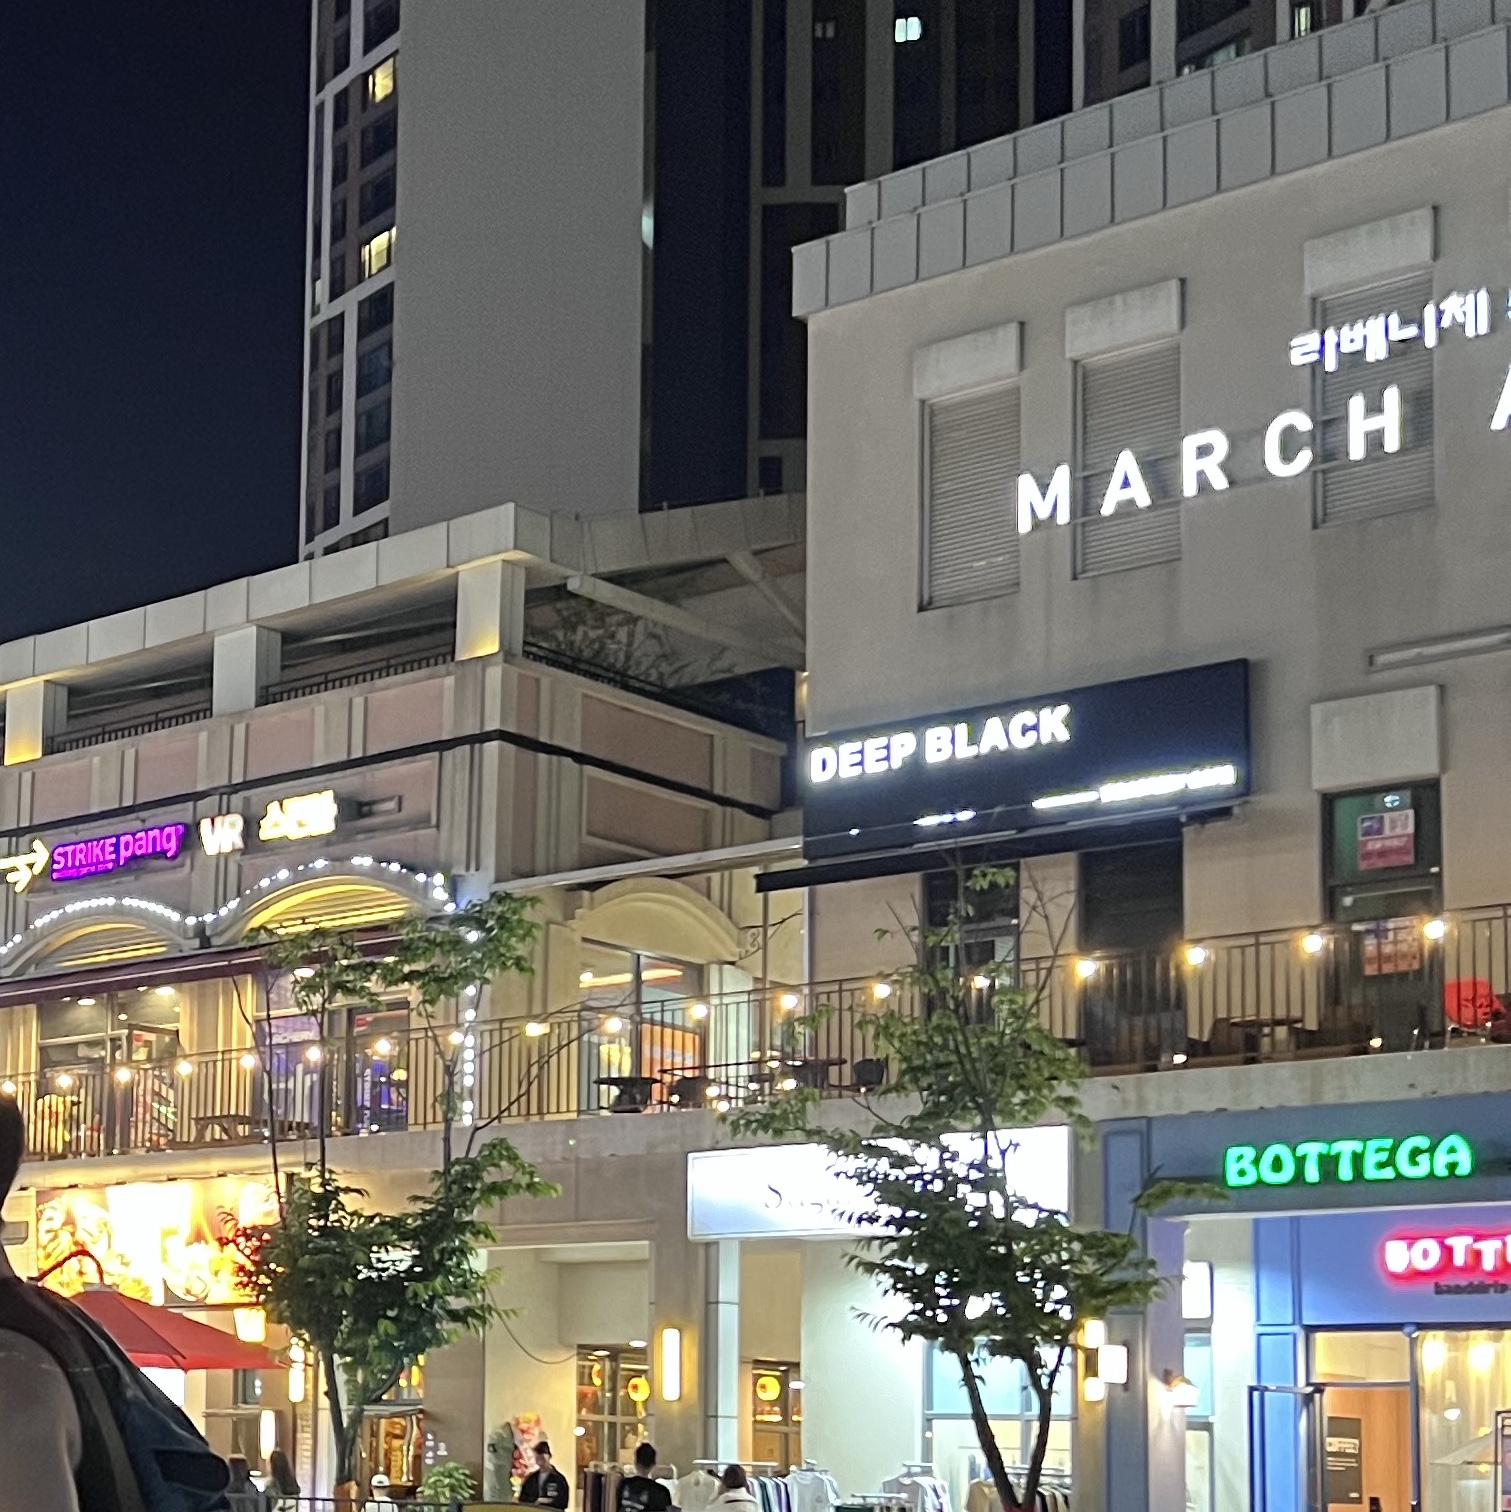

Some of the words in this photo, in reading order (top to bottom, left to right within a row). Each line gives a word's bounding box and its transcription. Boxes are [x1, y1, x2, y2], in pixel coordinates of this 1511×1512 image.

[1290, 287, 1491, 373] 라베니체
[1016, 384, 1402, 535] MARCH
[810, 731, 917, 783] DEEP
[924, 704, 1071, 764] BLACK
[52, 837, 116, 870] STRIKE
[119, 825, 176, 865] pang
[199, 813, 245, 856] VR
[1224, 1132, 1473, 1188] BOTTEGA
[1384, 1233, 1511, 1273] BOTT
